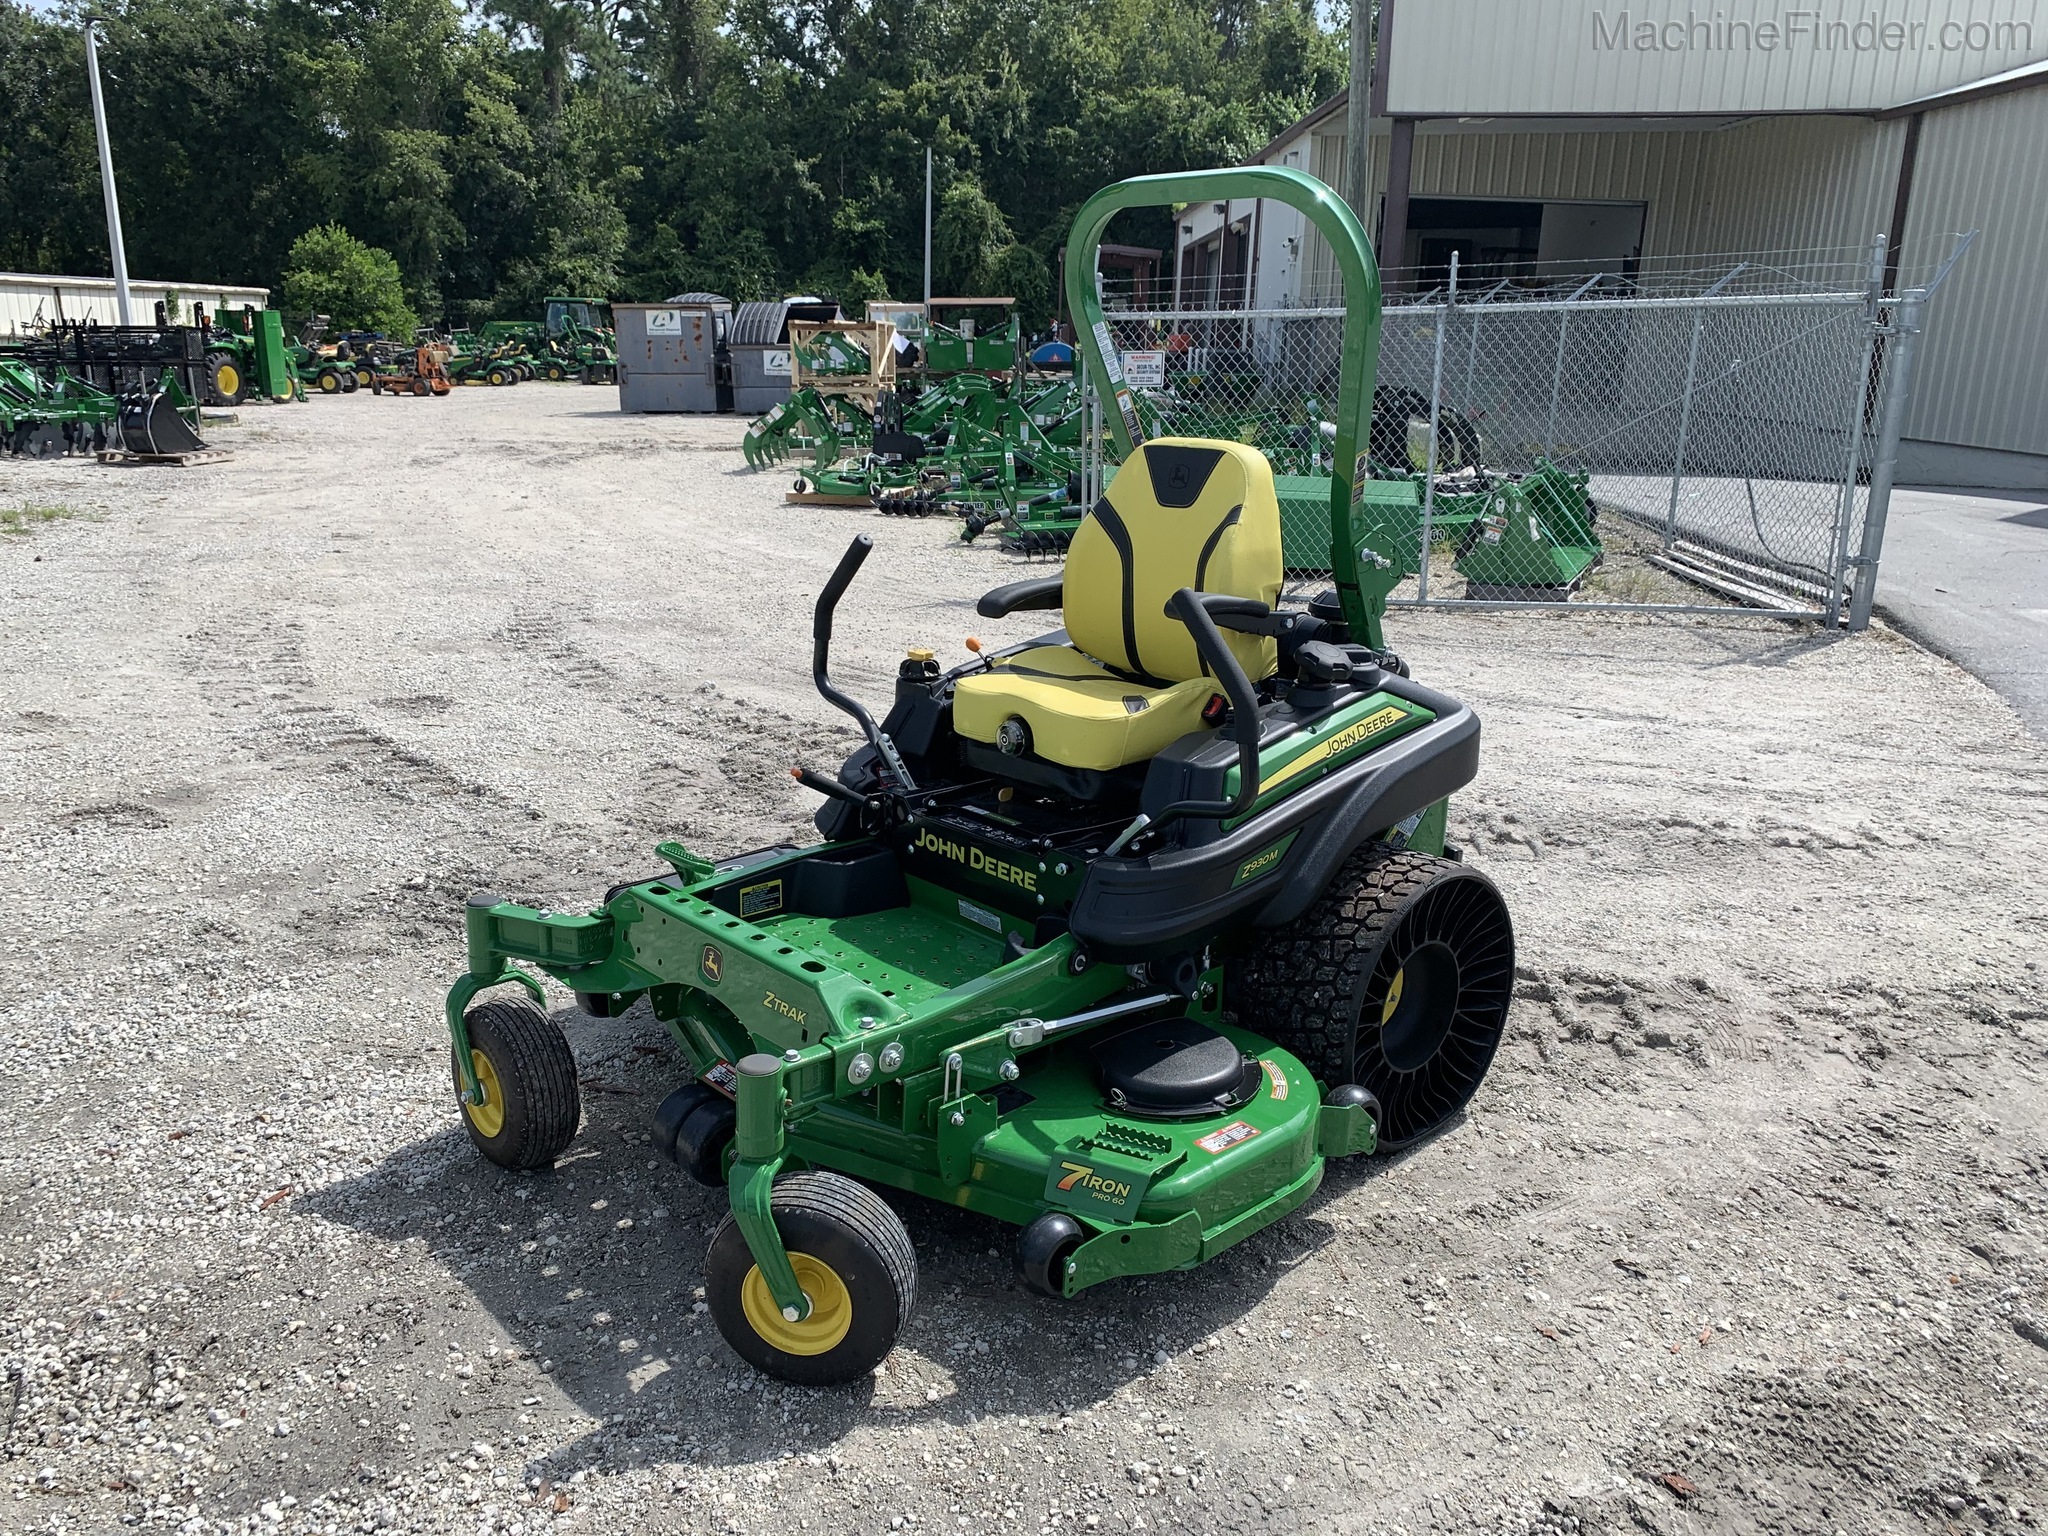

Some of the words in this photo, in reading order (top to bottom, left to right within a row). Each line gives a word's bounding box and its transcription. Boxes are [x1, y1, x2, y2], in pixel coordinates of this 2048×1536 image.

[1326, 730, 1357, 756] JOHN
[1356, 711, 1394, 739] DEERE
[915, 827, 965, 863] JOHN
[970, 846, 1037, 892] DEERE
[1241, 849, 1279, 879] Z930M
[763, 990, 807, 1025] ZTRAK
[1092, 1191, 1111, 1202] PRO
[1112, 1197, 1126, 1206] 60
